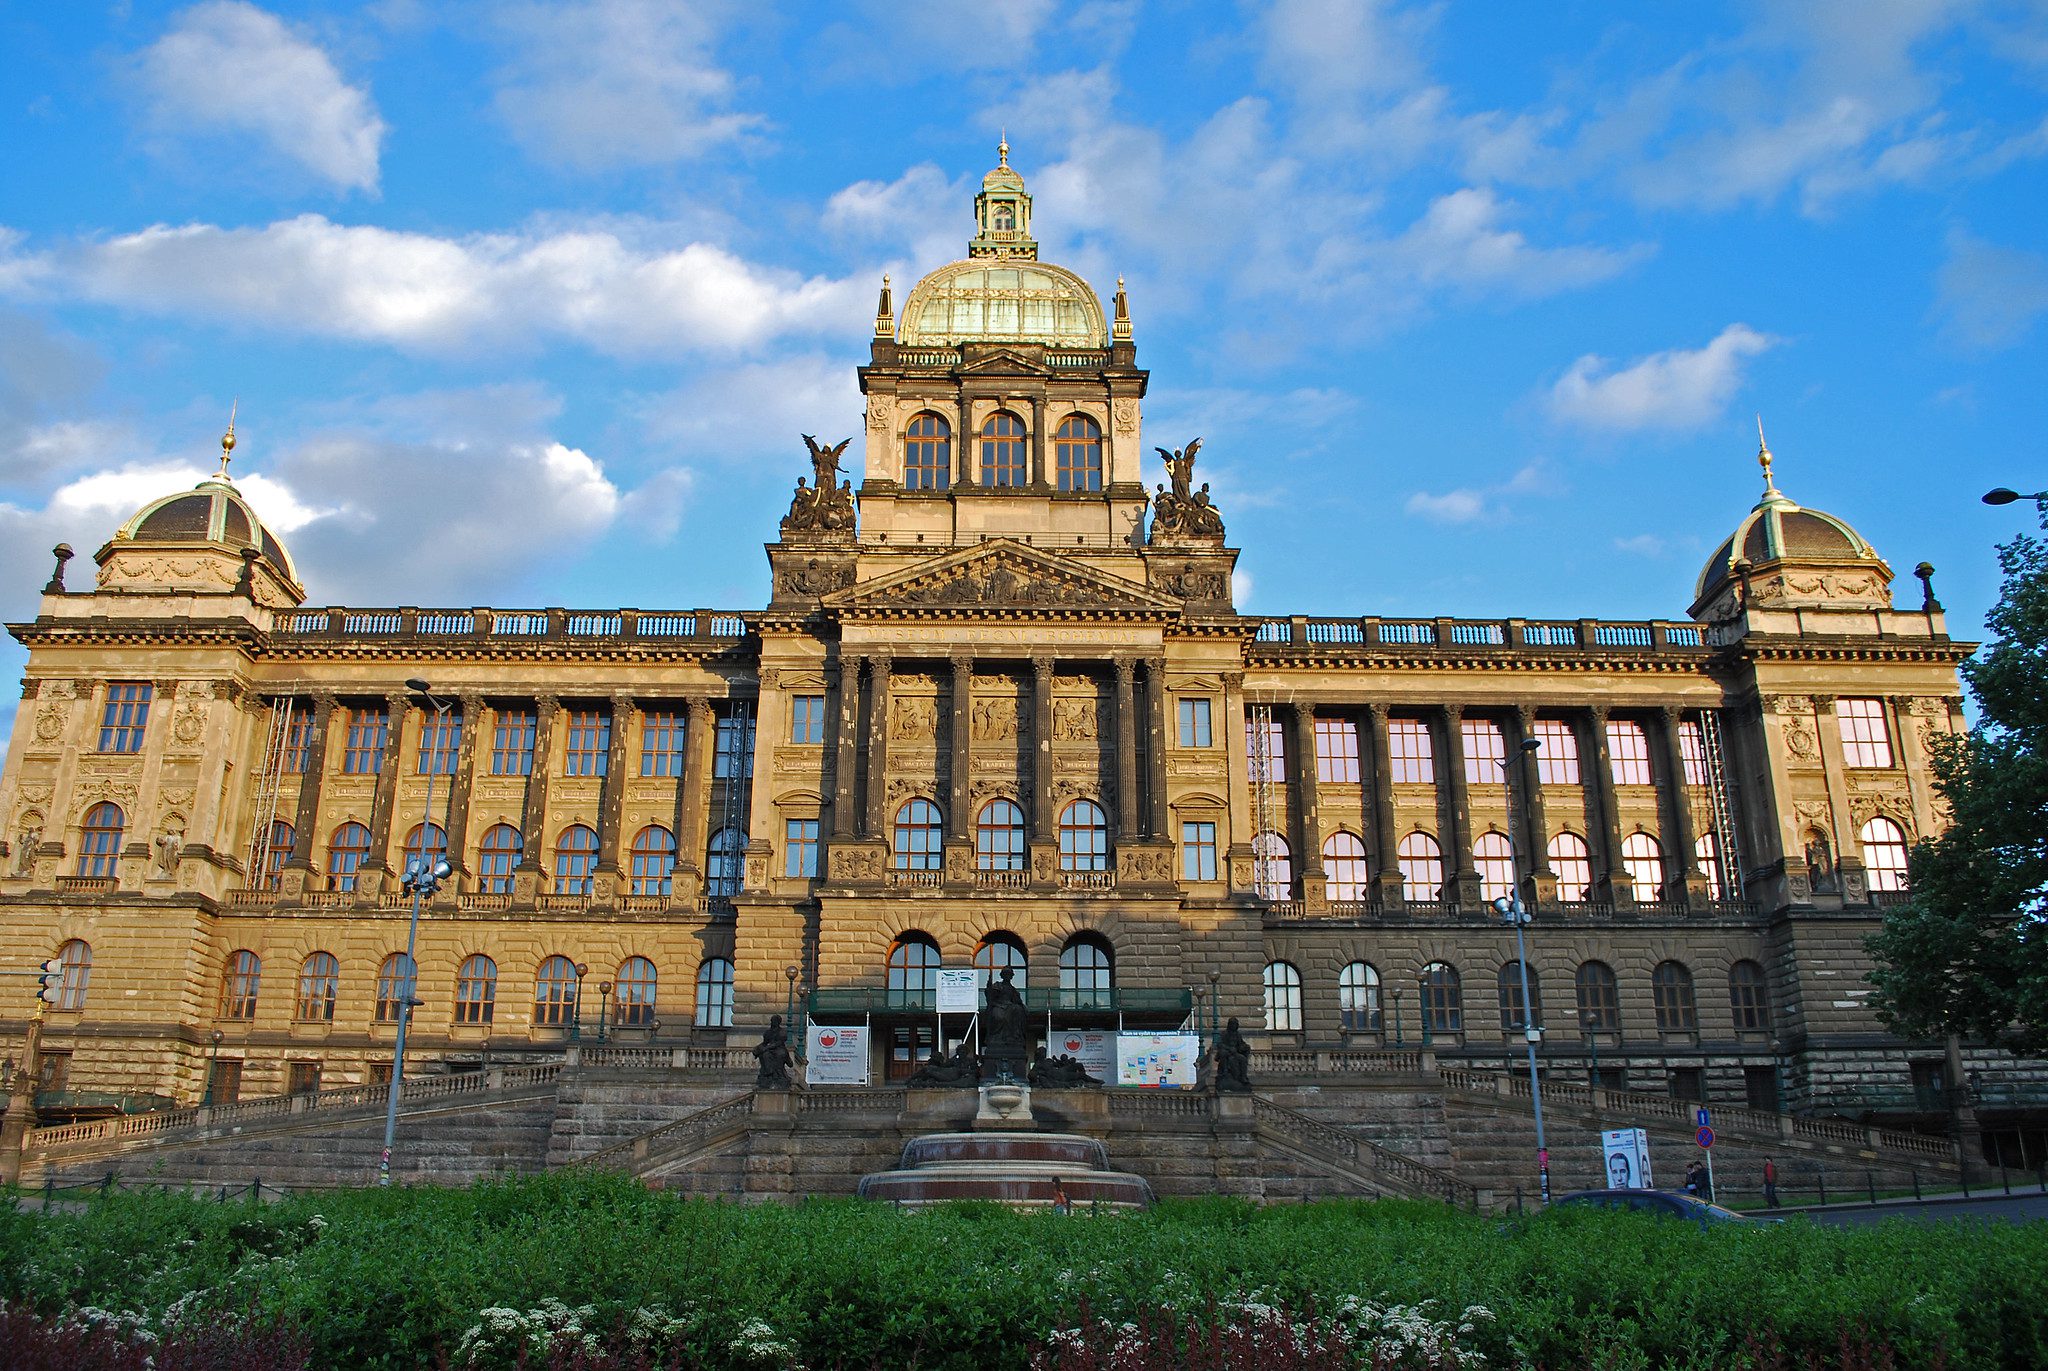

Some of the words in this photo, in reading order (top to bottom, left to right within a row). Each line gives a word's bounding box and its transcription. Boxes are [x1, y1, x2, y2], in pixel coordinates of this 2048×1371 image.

[866, 629, 946, 641] MUSEUM
[966, 630, 1026, 642] REGNI
[1046, 631, 1138, 643] BOHEMIAE
